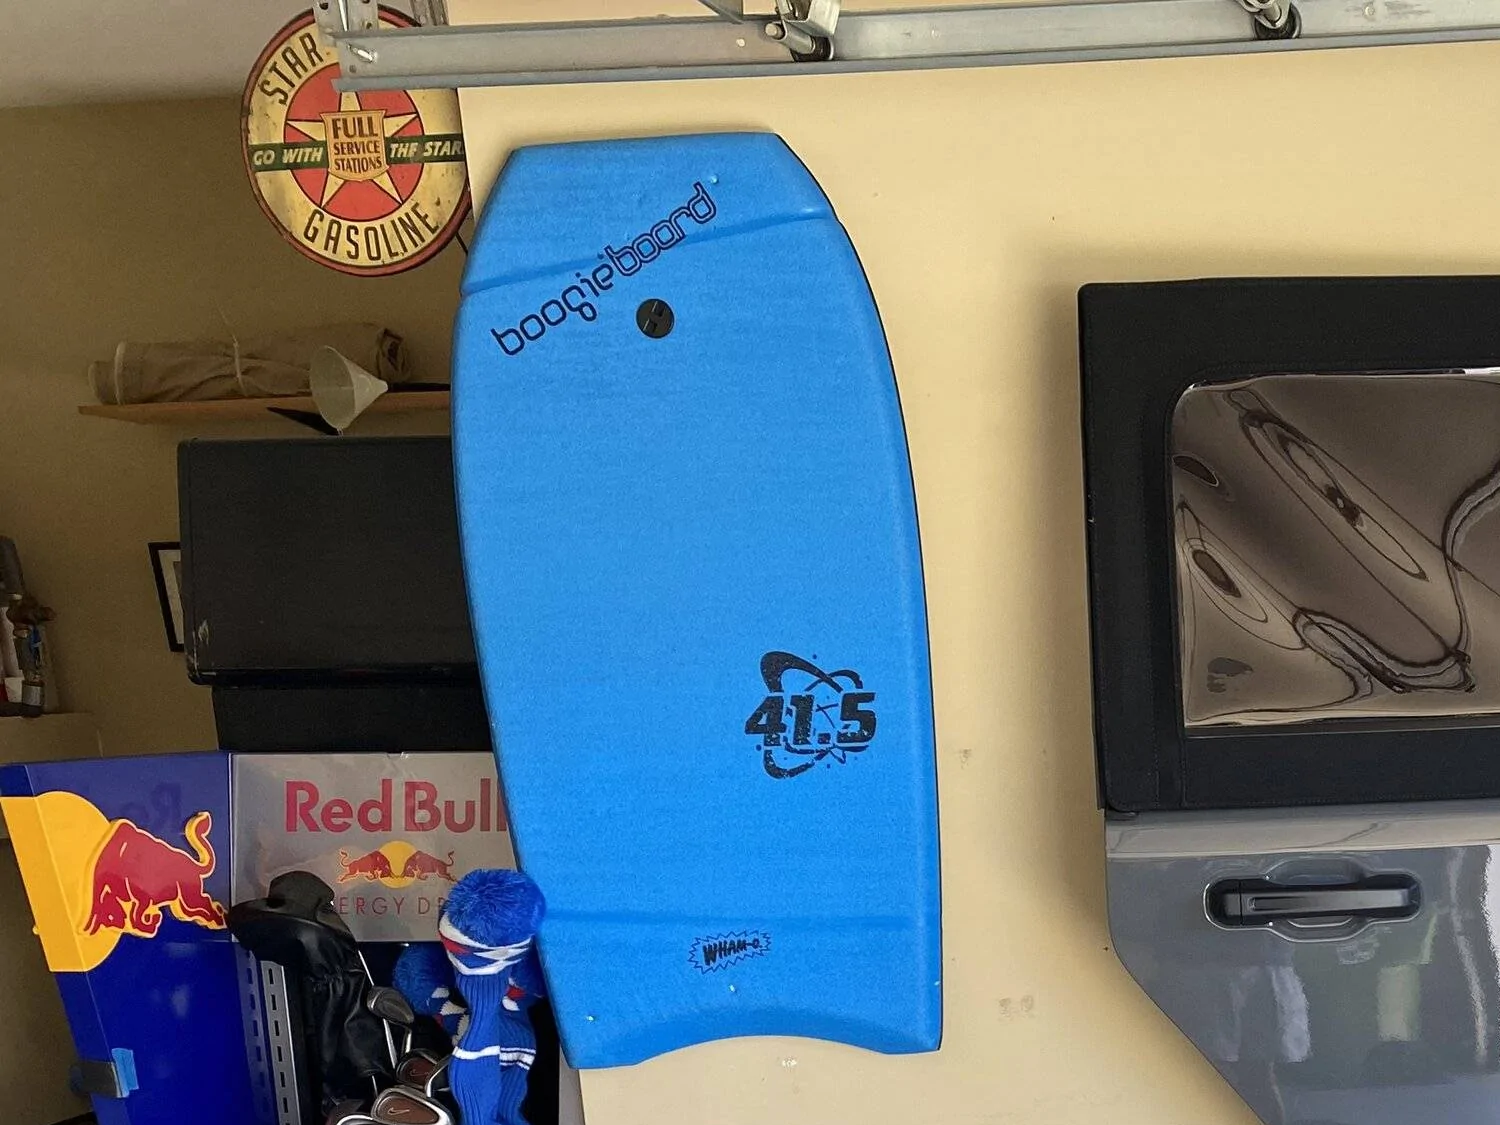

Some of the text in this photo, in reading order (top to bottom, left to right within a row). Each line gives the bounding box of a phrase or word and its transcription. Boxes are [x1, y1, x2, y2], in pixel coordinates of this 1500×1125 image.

[261, 32, 324, 106] STAR
[331, 116, 379, 139] FULL
[253, 140, 464, 166] GO WITH THE STAR
[333, 140, 381, 155] SERVICE
[334, 156, 383, 174] STATIONS
[303, 202, 440, 261] GASOLINE
[744, 691, 877, 747] 41.5
[285, 778, 393, 833] Red
[338, 896, 405, 914] ERGY
